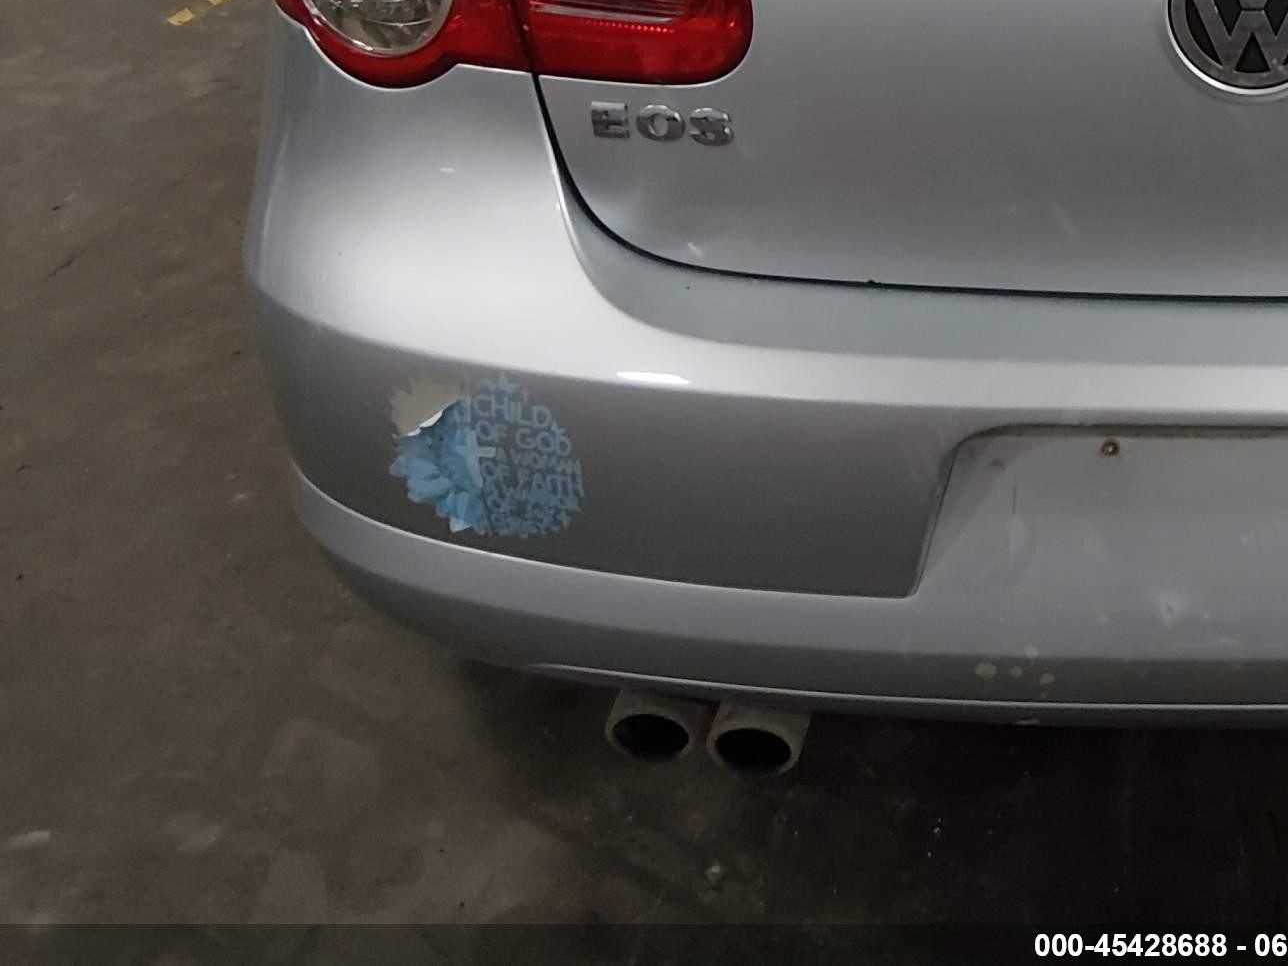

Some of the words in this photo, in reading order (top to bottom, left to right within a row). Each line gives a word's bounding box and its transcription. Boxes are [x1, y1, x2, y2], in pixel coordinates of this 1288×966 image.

[590, 100, 735, 146] EOS
[473, 393, 553, 427] CHILD
[475, 420, 507, 443] OF
[515, 427, 573, 457] GOD
[481, 462, 511, 483] OF
[517, 468, 585, 498] FAITH
